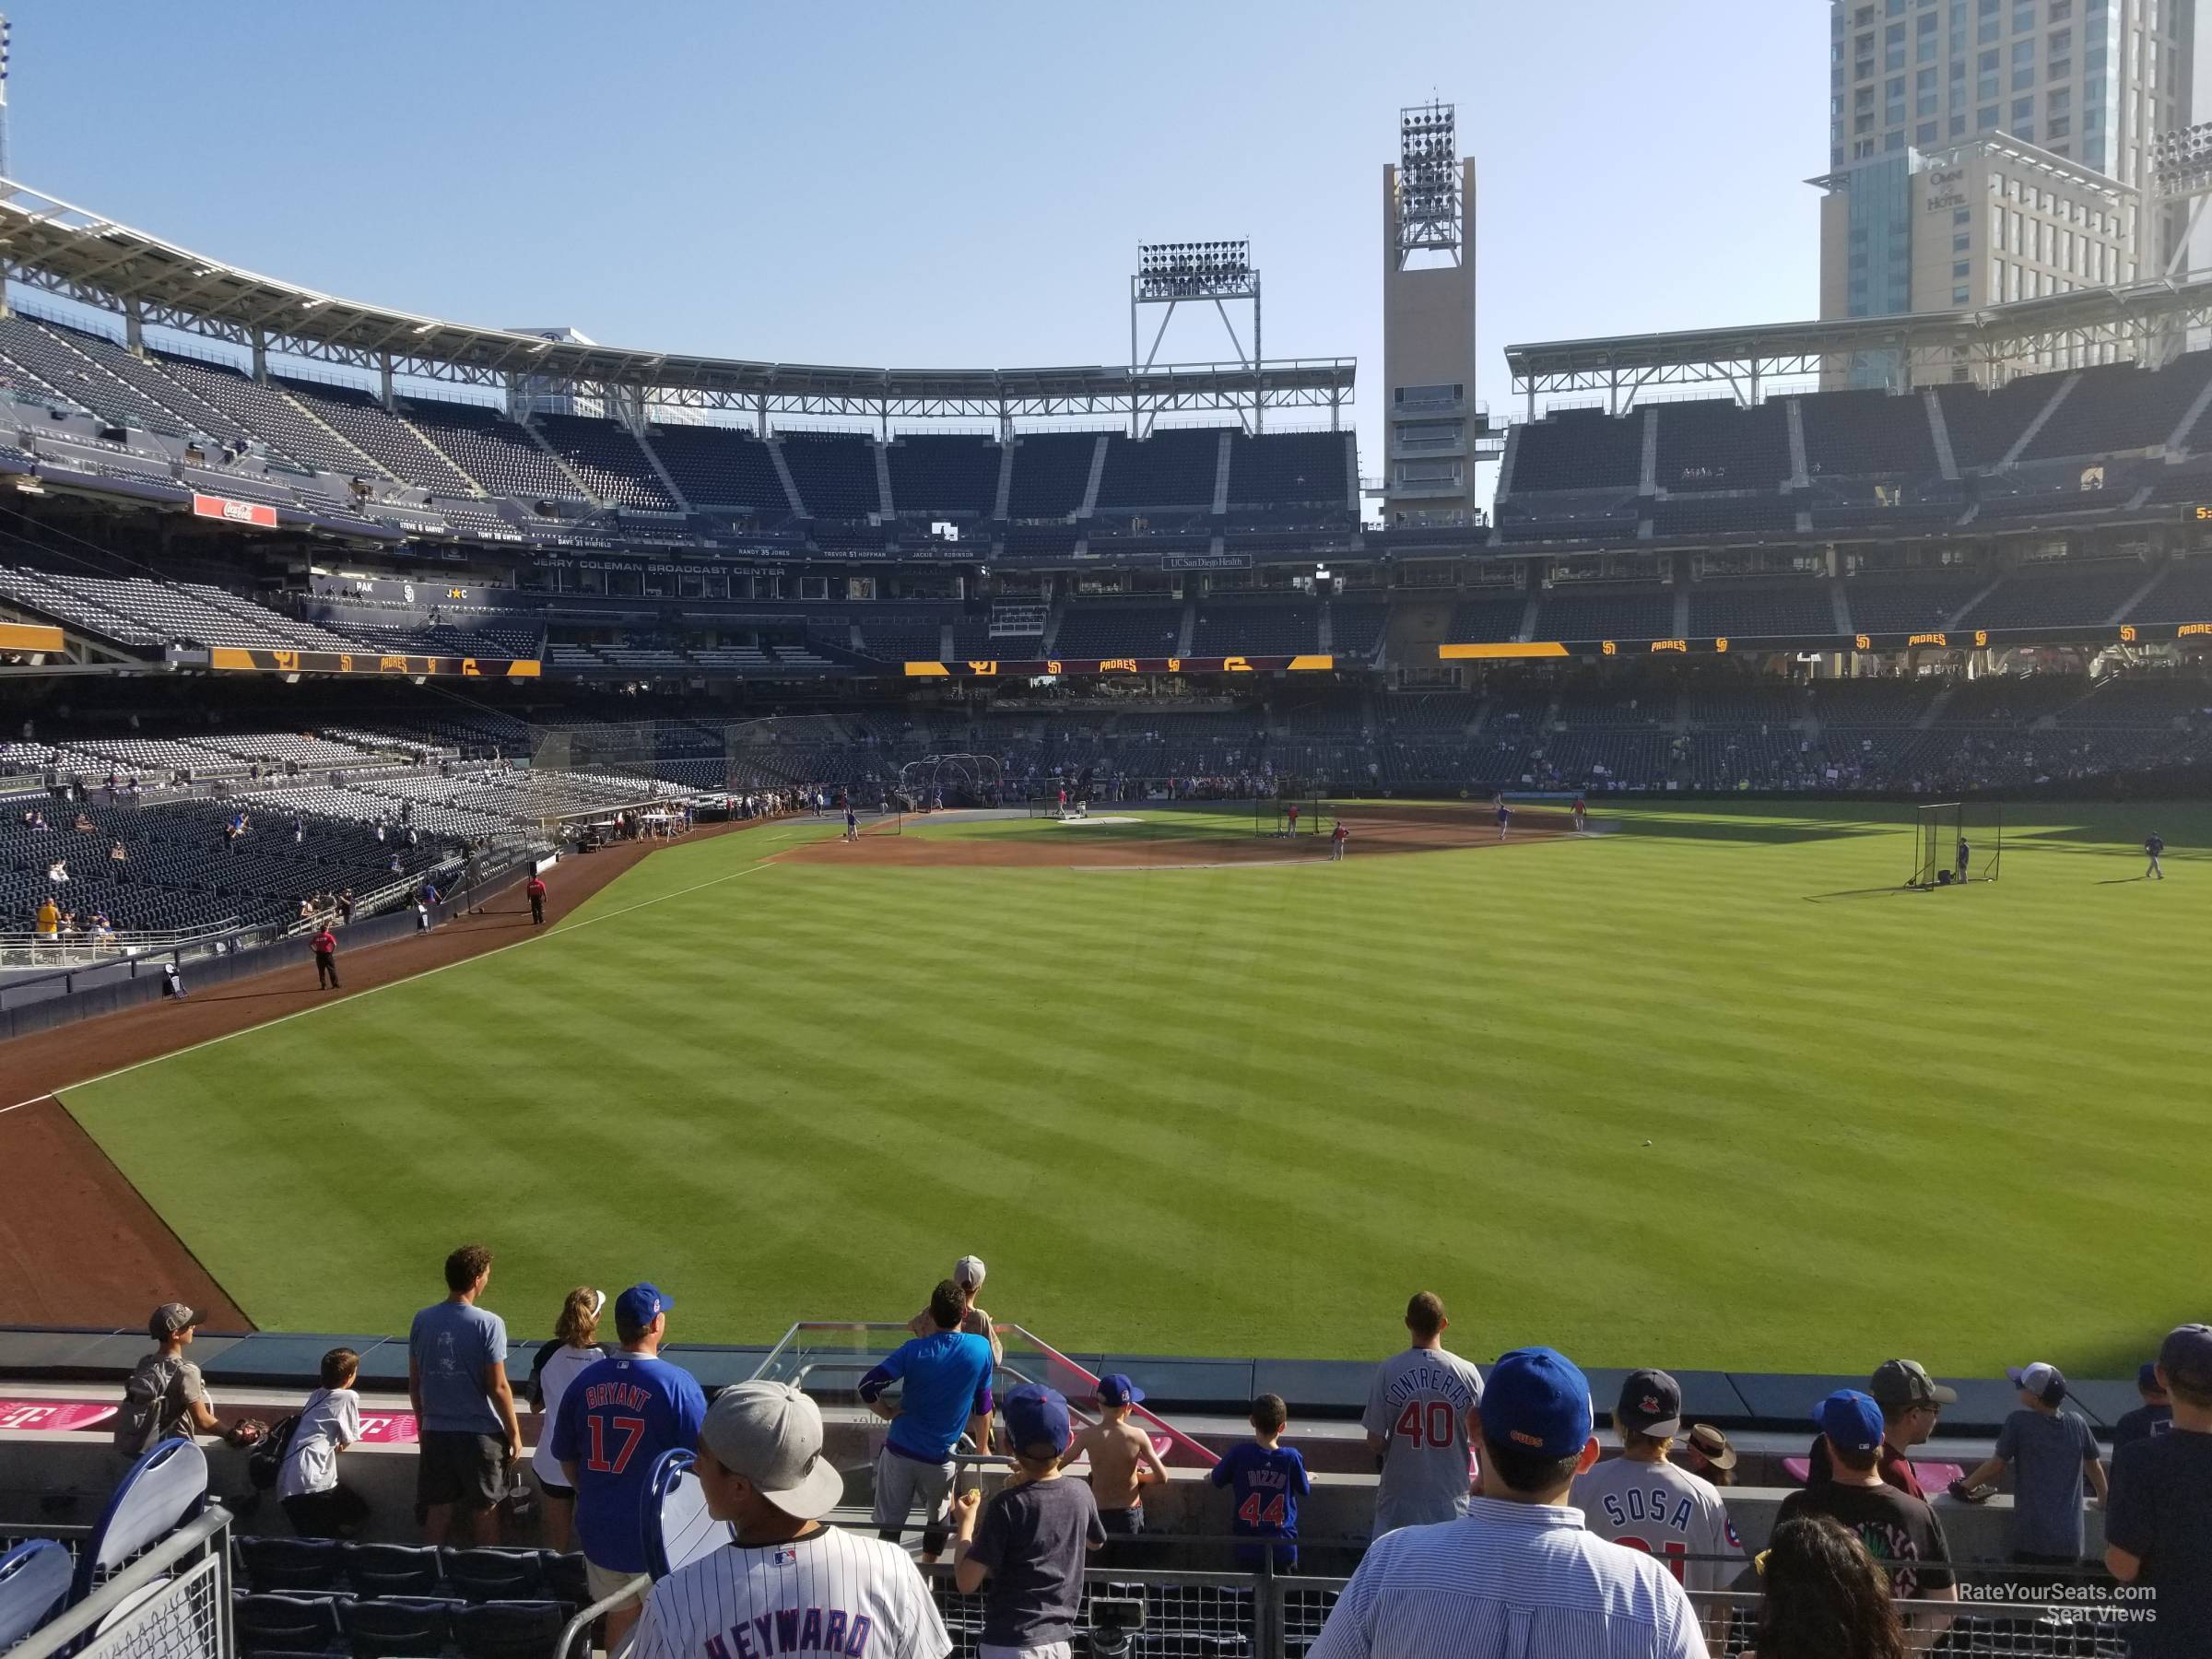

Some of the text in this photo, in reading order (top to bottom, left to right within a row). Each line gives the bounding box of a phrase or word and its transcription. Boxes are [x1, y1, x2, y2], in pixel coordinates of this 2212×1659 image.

[399, 522, 416, 530] STEVE
[425, 524, 444, 534] GARVEY
[477, 531, 492, 539] TONY
[532, 558, 785, 576] JERRY COLEMAN BROADCAST CENTER
[1171, 557, 1242, 568] UC San Diego Health
[2177, 623, 2212, 638] PADRE
[1651, 640, 1686, 653] PADRES
[1909, 633, 1947, 647] PADRES
[381, 655, 407, 673] PADRES
[1100, 658, 1137, 673] PADRES
[1384, 1366, 1473, 1410] CONTRERAS
[585, 1382, 652, 1413] BRYANT
[1394, 1400, 1454, 1450] 40
[587, 1415, 645, 1474] 17
[1247, 1469, 1287, 1489] RIZZO
[1238, 1492, 1285, 1527] 44
[1602, 1487, 1693, 1534] SOSA
[704, 1607, 871, 1659] HEYWARD
